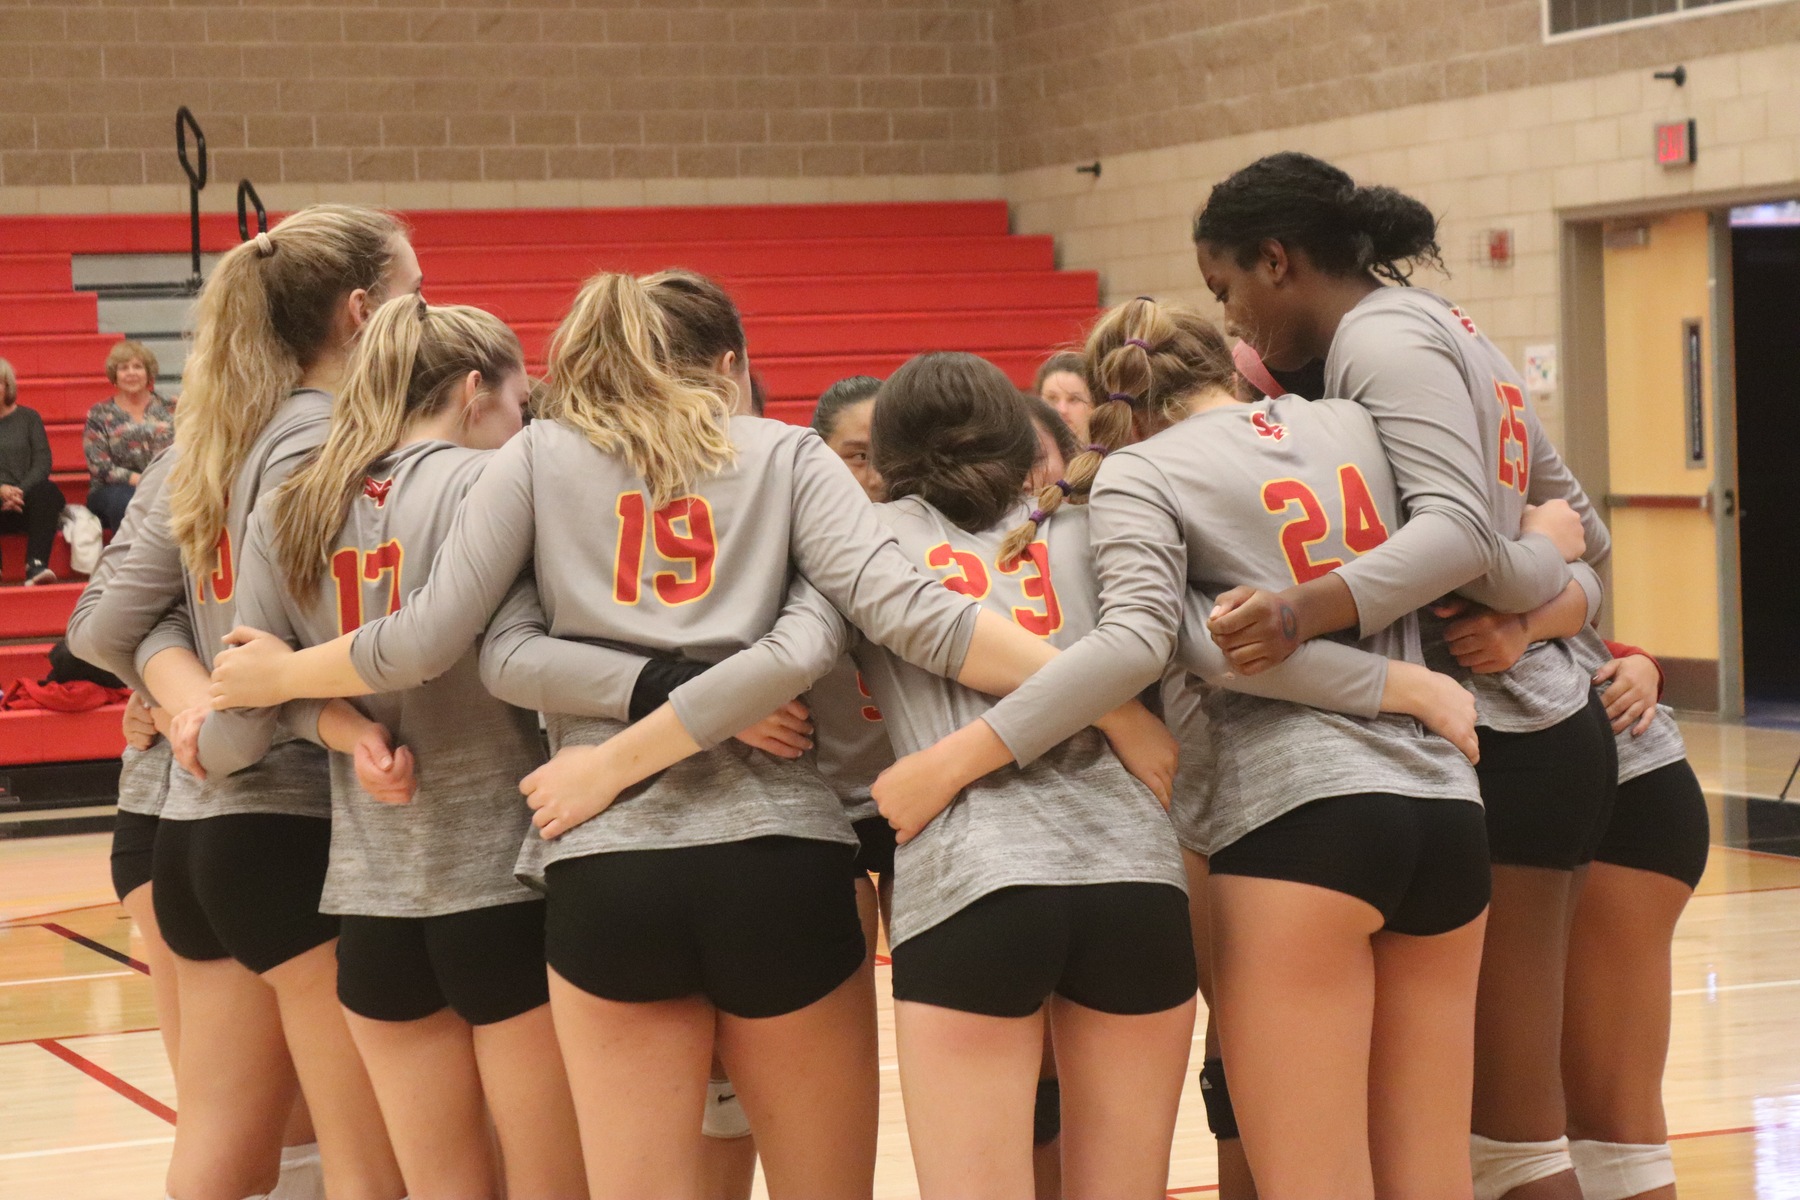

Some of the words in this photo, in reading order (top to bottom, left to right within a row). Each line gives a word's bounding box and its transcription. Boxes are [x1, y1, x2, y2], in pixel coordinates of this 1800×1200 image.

[1657, 124, 1685, 163] EXIT
[612, 489, 718, 608] 19
[1260, 463, 1390, 586] 24
[330, 537, 404, 637] 17
[924, 538, 1064, 639] 23
